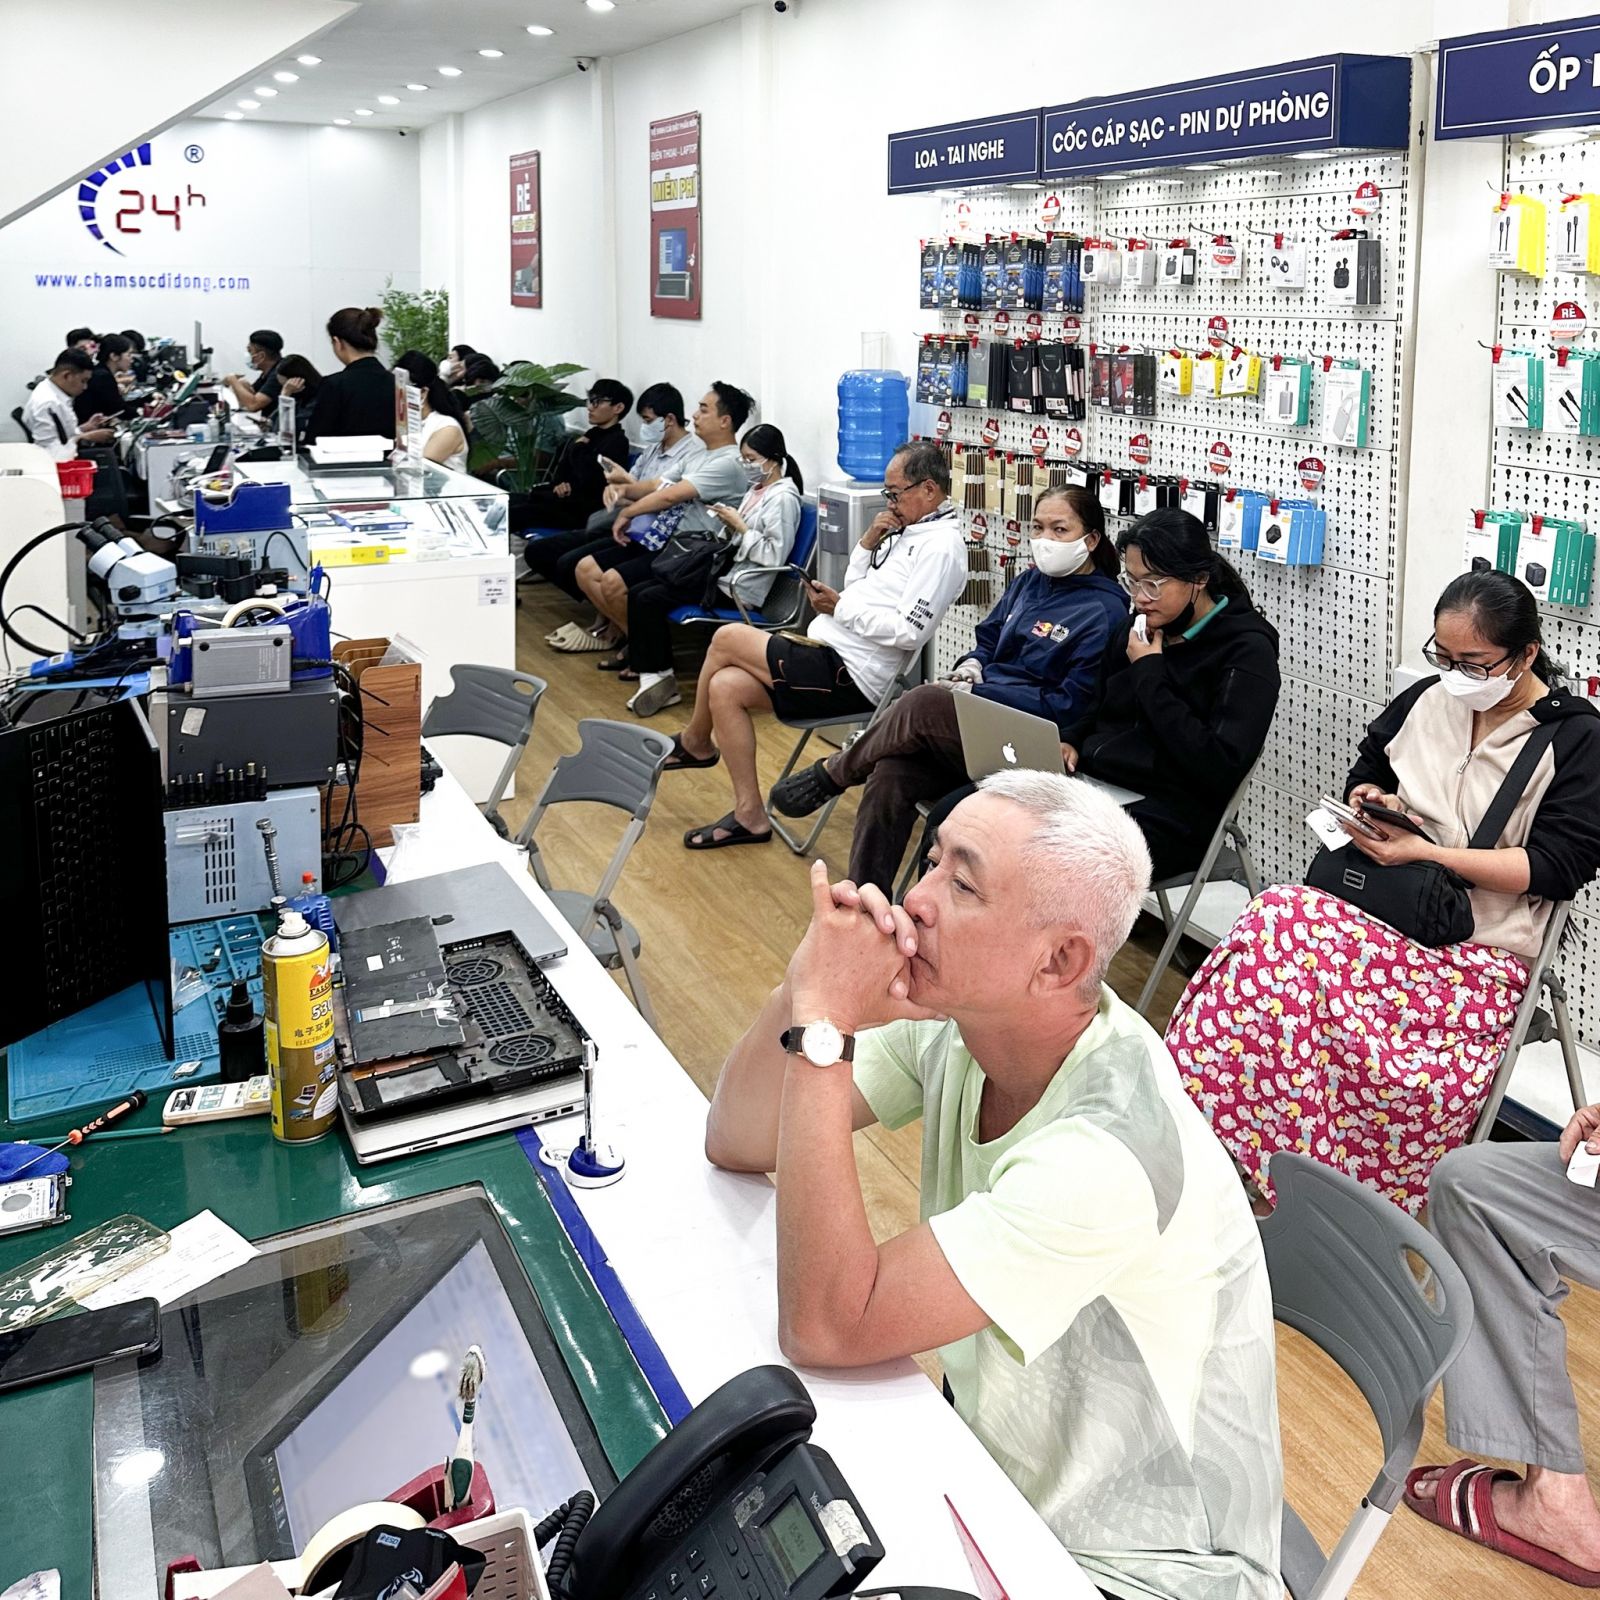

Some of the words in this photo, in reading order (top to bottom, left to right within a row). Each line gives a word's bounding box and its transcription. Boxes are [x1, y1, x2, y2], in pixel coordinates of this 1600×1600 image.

[1528, 42, 1581, 94] ỐP
[1052, 121, 1088, 154] CỐC
[1091, 118, 1126, 148] CÁP
[1129, 116, 1165, 148] SẠC
[1179, 109, 1210, 137] PIN
[1216, 100, 1246, 136] DỰ
[1249, 90, 1330, 127] PHÒNG
[915, 149, 938, 169] LOA
[947, 145, 965, 165] TAI
[968, 138, 1004, 162] NGHE
[35, 272, 250, 292] www.chamsocdidong.com
[1561, 304, 1577, 319] RẺ
[1305, 459, 1319, 470] RẺ
